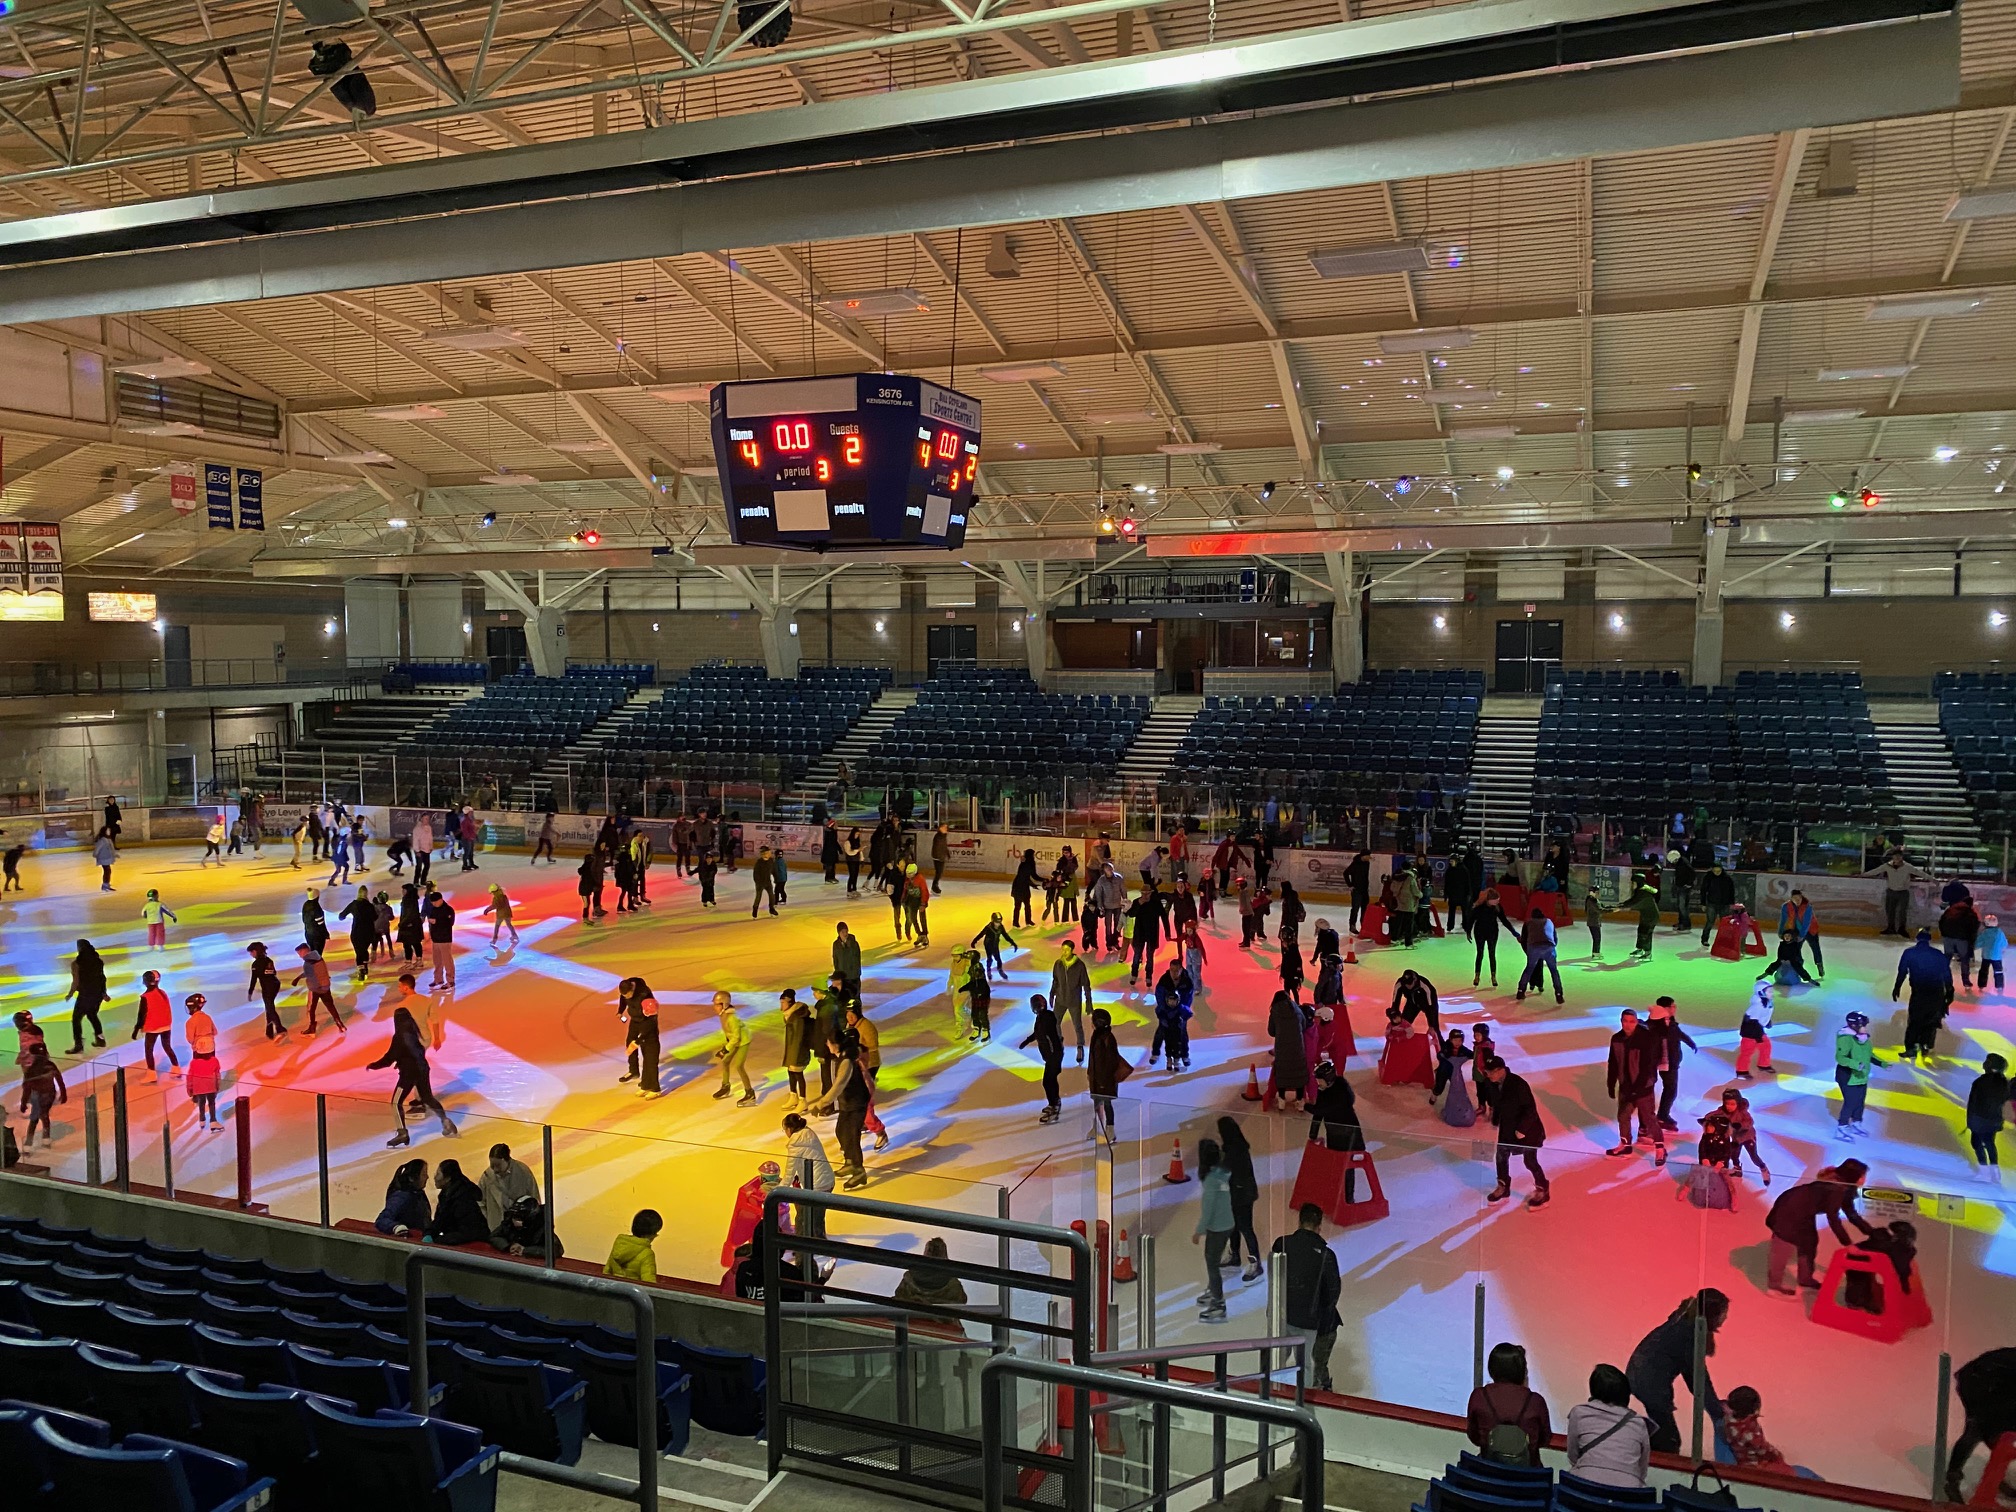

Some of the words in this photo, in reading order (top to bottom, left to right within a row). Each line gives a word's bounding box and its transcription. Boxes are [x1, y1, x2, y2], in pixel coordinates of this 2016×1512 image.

[878, 388, 902, 399] 3676
[866, 398, 902, 406] KENSINGTON
[933, 401, 953, 419] SPORTS
[953, 407, 973, 426] CENTRE
[729, 428, 754, 441] Home
[775, 423, 810, 450] 0.0
[829, 423, 859, 436] Guests
[742, 442, 759, 467] 4
[846, 437, 860, 463] 2
[921, 443, 931, 468] 4
[783, 465, 811, 479] period
[817, 459, 828, 479] 3
[966, 456, 977, 480] 2
[950, 472, 959, 490] 3
[740, 505, 770, 518] penalty
[834, 502, 864, 516] penalty
[278, 808, 302, 817] Level
[527, 828, 541, 838] tea
[561, 830, 577, 841] phil
[576, 830, 595, 842] haig
[1595, 867, 1610, 877] Be
[1594, 878, 1612, 888] the
[1868, 1190, 1906, 1200] CAUTION
